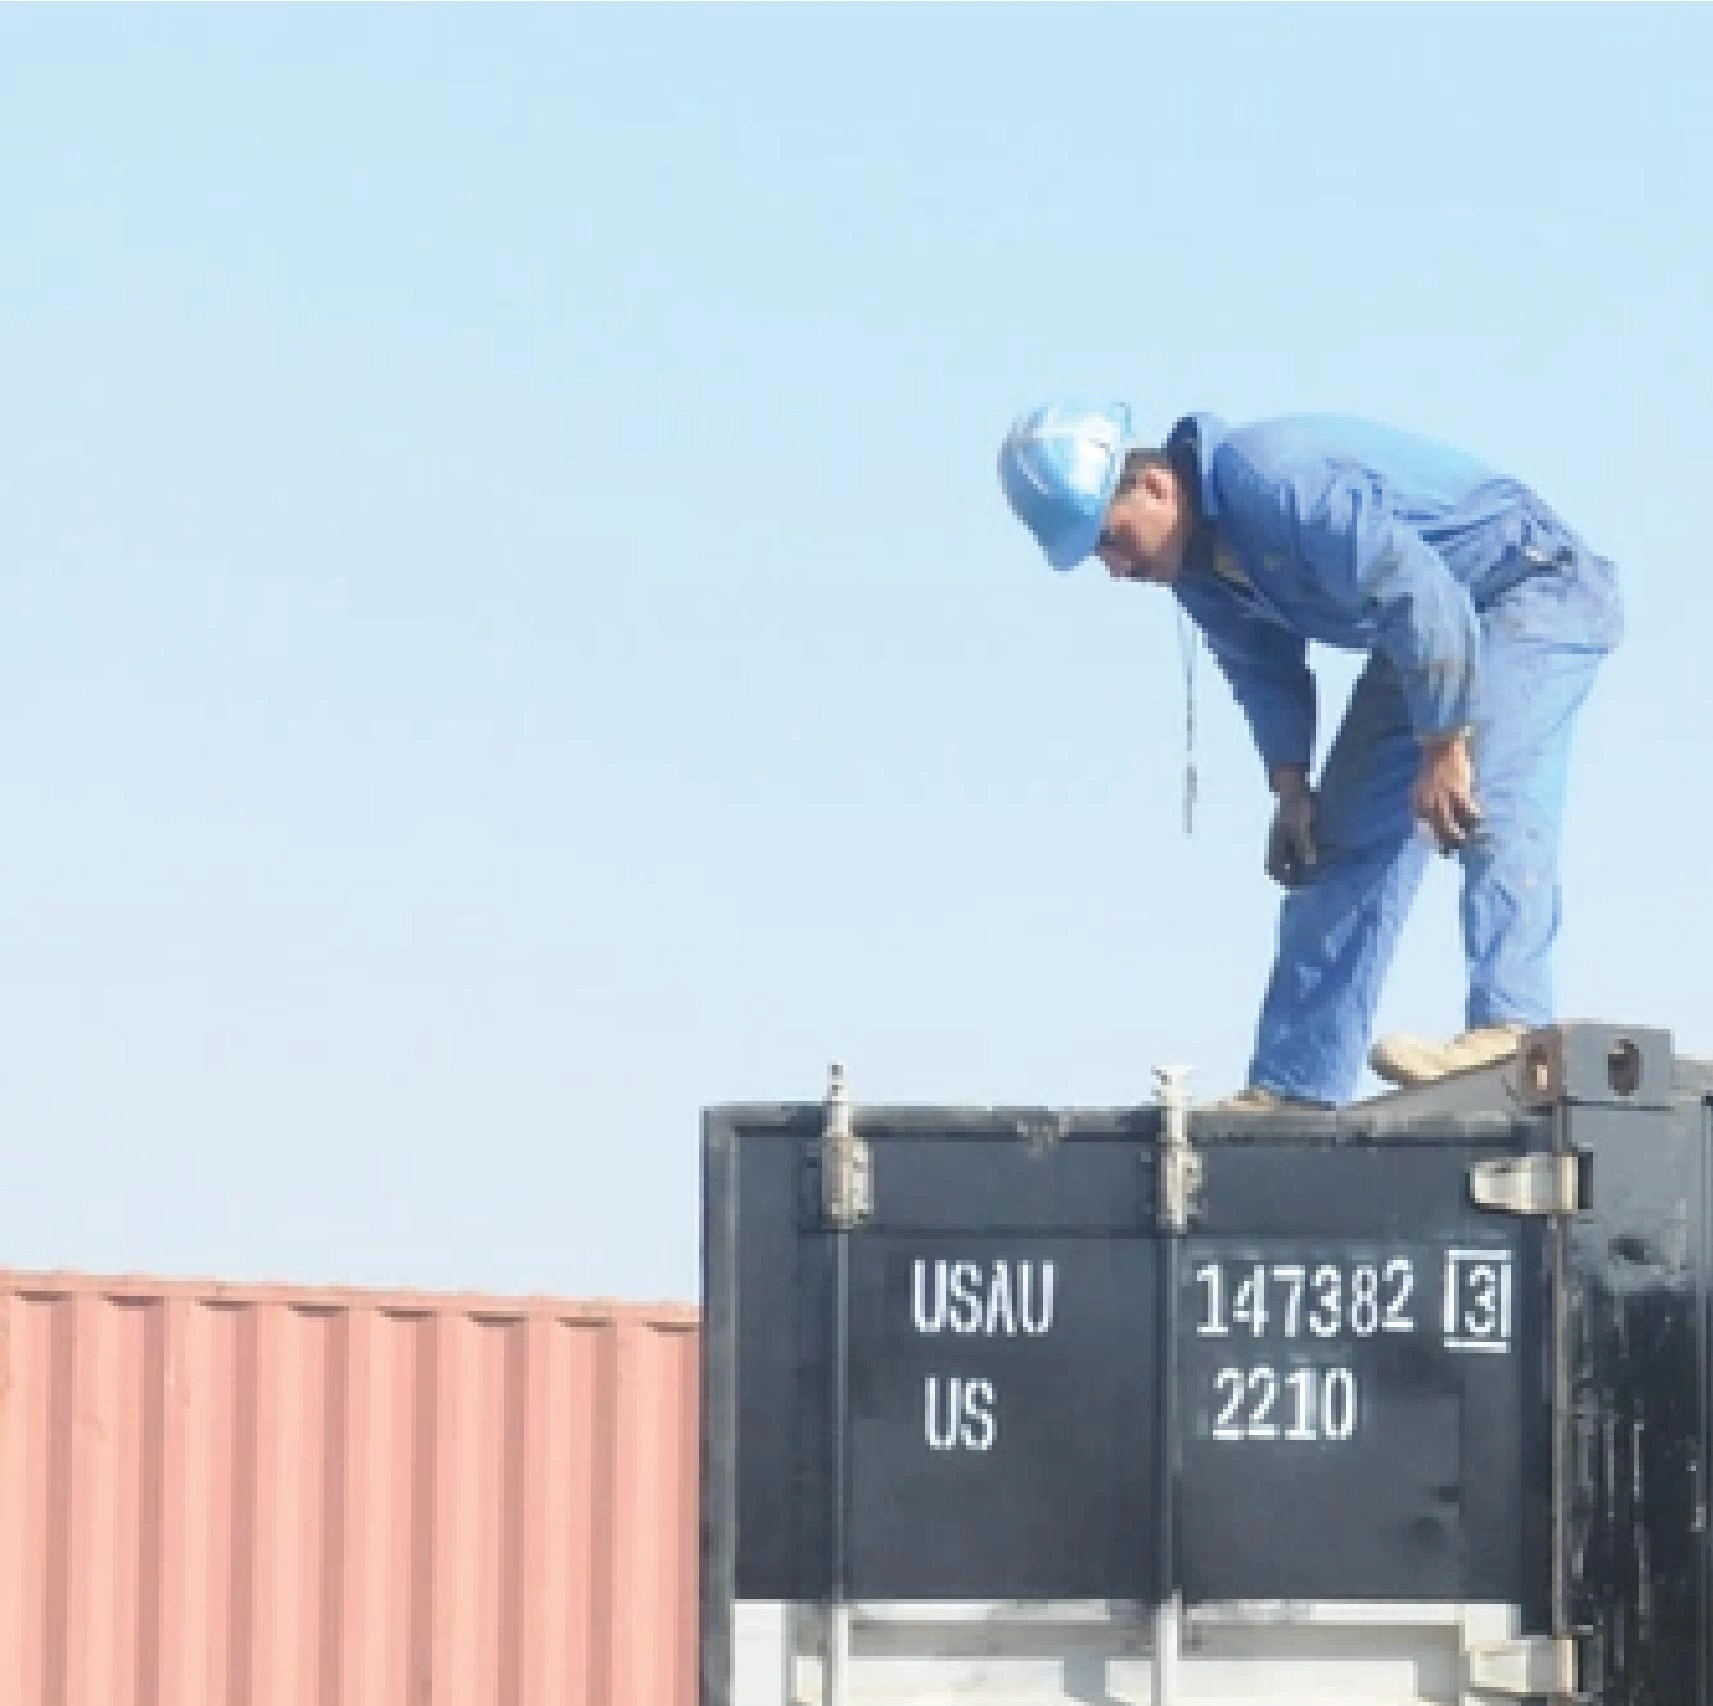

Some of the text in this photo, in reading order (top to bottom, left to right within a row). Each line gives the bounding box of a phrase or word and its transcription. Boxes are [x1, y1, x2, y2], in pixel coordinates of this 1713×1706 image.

[910, 1258, 1055, 1337] USAU
[1194, 1256, 1416, 1338] 147382
[924, 1366, 1357, 1450] US 2210
